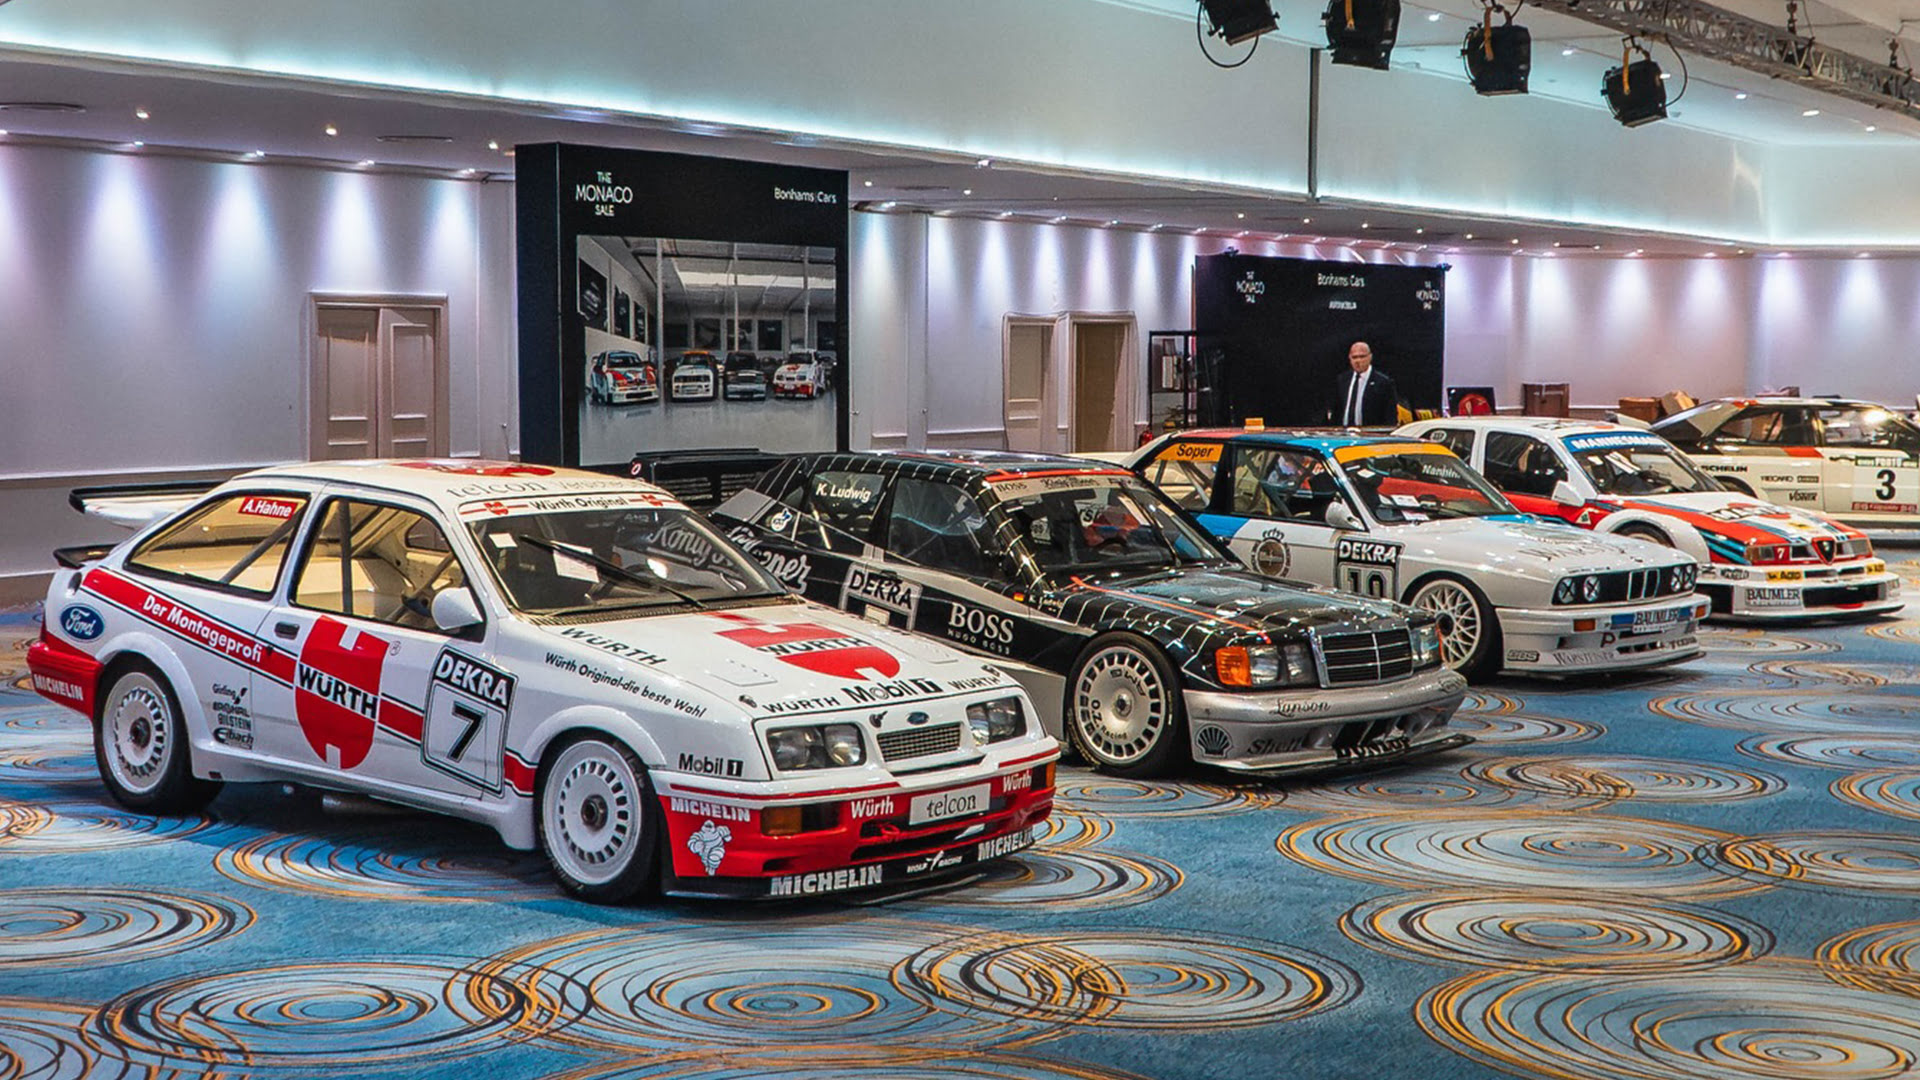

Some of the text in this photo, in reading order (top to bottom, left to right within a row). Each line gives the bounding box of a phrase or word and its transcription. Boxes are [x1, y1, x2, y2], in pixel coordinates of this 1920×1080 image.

[597, 171, 612, 183] THE
[576, 185, 634, 204] MONACO
[773, 187, 837, 204] Bonhams Cars
[595, 205, 615, 217] SALE
[1317, 272, 1349, 287] Bonhams
[1176, 443, 1215, 459] Soper
[815, 482, 872, 503] K. Ludwig
[1875, 469, 1896, 501] 3
[242, 497, 293, 518] A.Hahne
[529, 495, 629, 512] Würth Original
[1337, 539, 1399, 564] DEKRA
[1777, 547, 1785, 559] 7
[848, 570, 913, 611] DEKRA
[65, 609, 98, 636] Ford
[142, 594, 264, 664] Der Montageprofi
[947, 601, 1015, 644] BOSS
[561, 627, 669, 666] WÜRTH
[32, 672, 84, 701] MICHELIN
[299, 663, 379, 720] WÜRTH
[434, 653, 510, 707] DEKRA
[544, 651, 577, 673] Würth
[641, 684, 672, 706] beste
[673, 698, 707, 718] Wahl
[842, 678, 919, 704] Mobil
[946, 676, 1000, 691] WÜRTH
[762, 695, 842, 714] WÜRTH
[217, 712, 252, 731] BILSTEIN
[446, 700, 487, 764] 7
[212, 727, 255, 746] Eibach
[1247, 737, 1303, 756] Shell
[678, 753, 744, 778] Mobil 1
[1002, 772, 1033, 794] Würth
[670, 797, 751, 823] MICHELIN
[849, 795, 895, 821] Würth
[925, 792, 978, 819] telcon
[977, 827, 1034, 863] MICHELIN
[770, 864, 884, 897] MICHELIN
